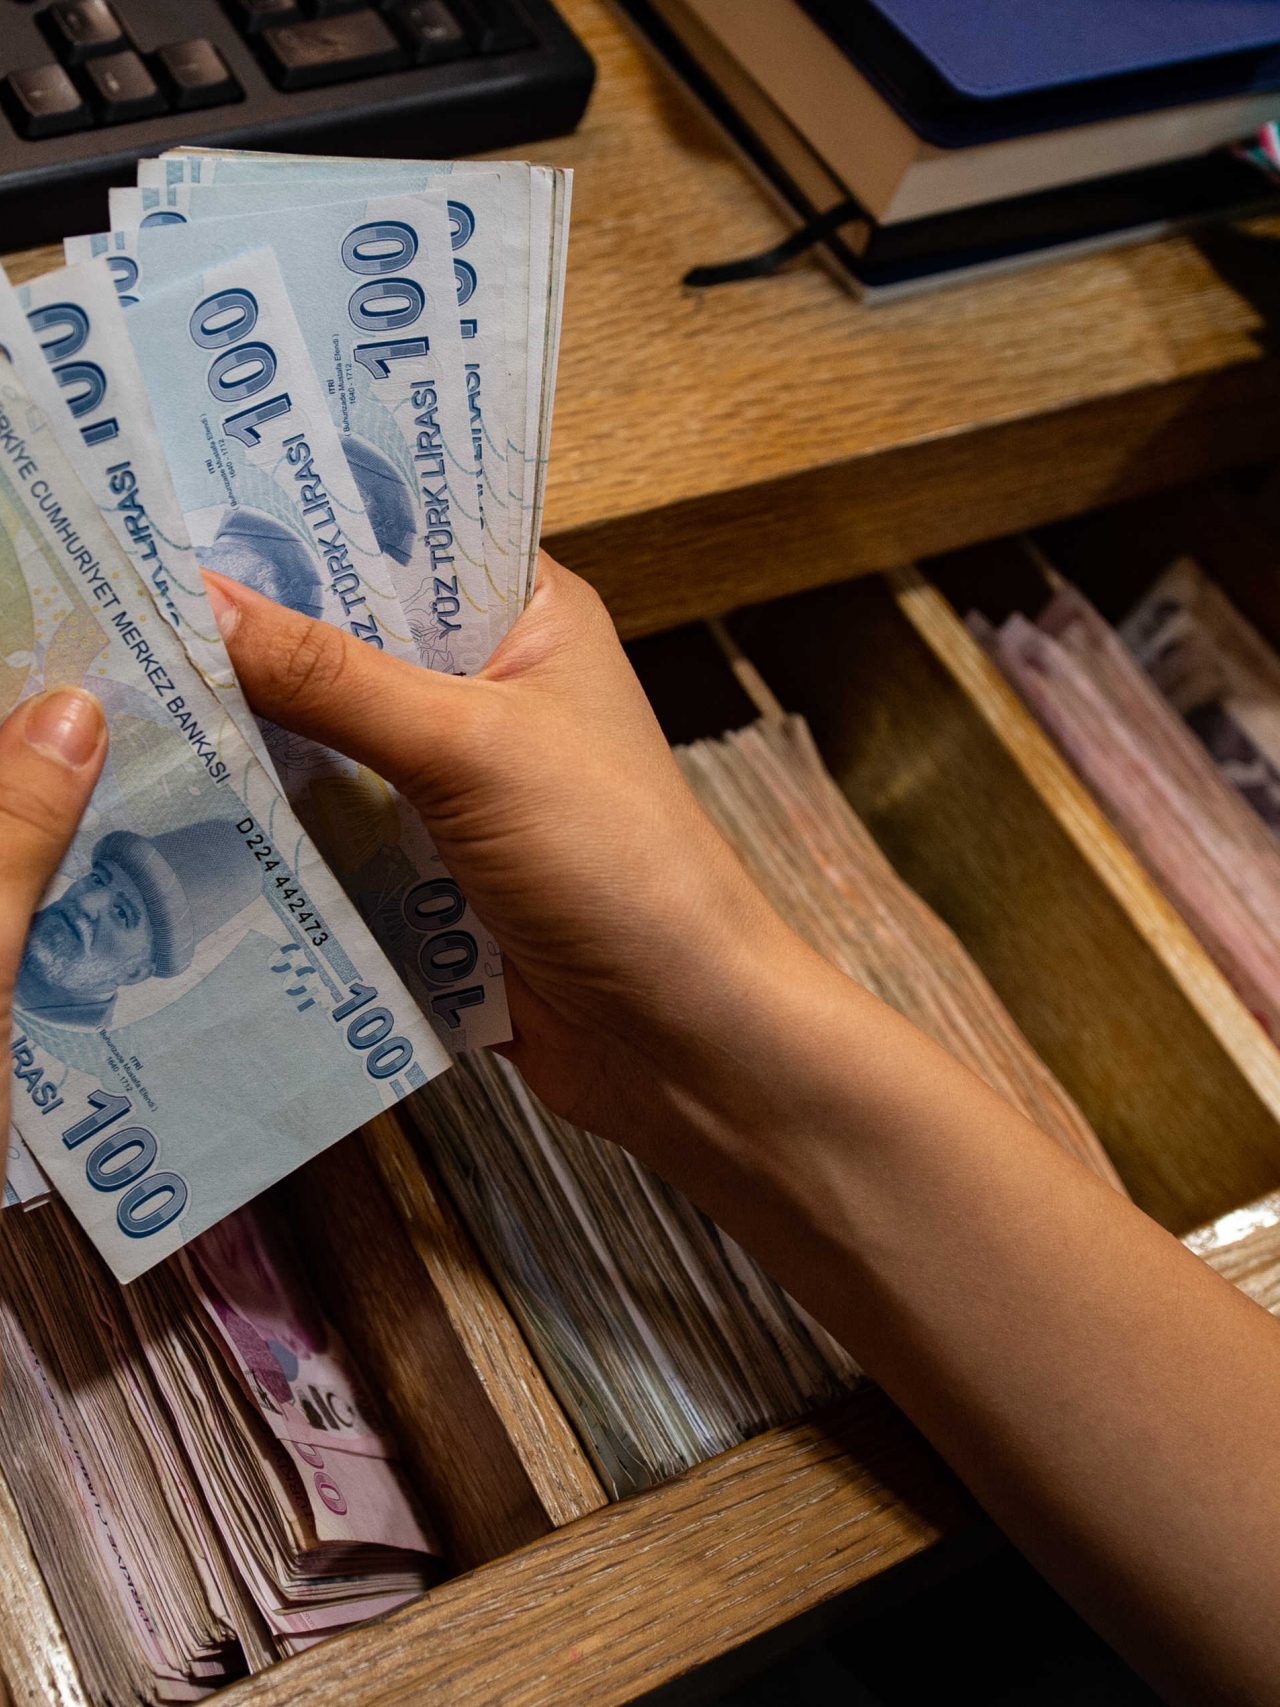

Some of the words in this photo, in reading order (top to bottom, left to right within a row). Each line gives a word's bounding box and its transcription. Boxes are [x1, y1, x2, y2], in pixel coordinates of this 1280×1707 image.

[190, 288, 292, 447] 100
[341, 220, 430, 379] 100
[318, 530, 366, 616] TÜRK
[423, 484, 455, 571] TÜRK
[31, 480, 121, 609] CUMHURİYET
[111, 611, 175, 697] MERKEZ
[166, 696, 231, 783] BANKASI
[433, 575, 461, 639] YÜZ
[236, 818, 280, 872] D224
[275, 875, 328, 946] 442473
[404, 878, 485, 1029] 100
[332, 982, 413, 1079] 100
[62, 1089, 188, 1238] 100
